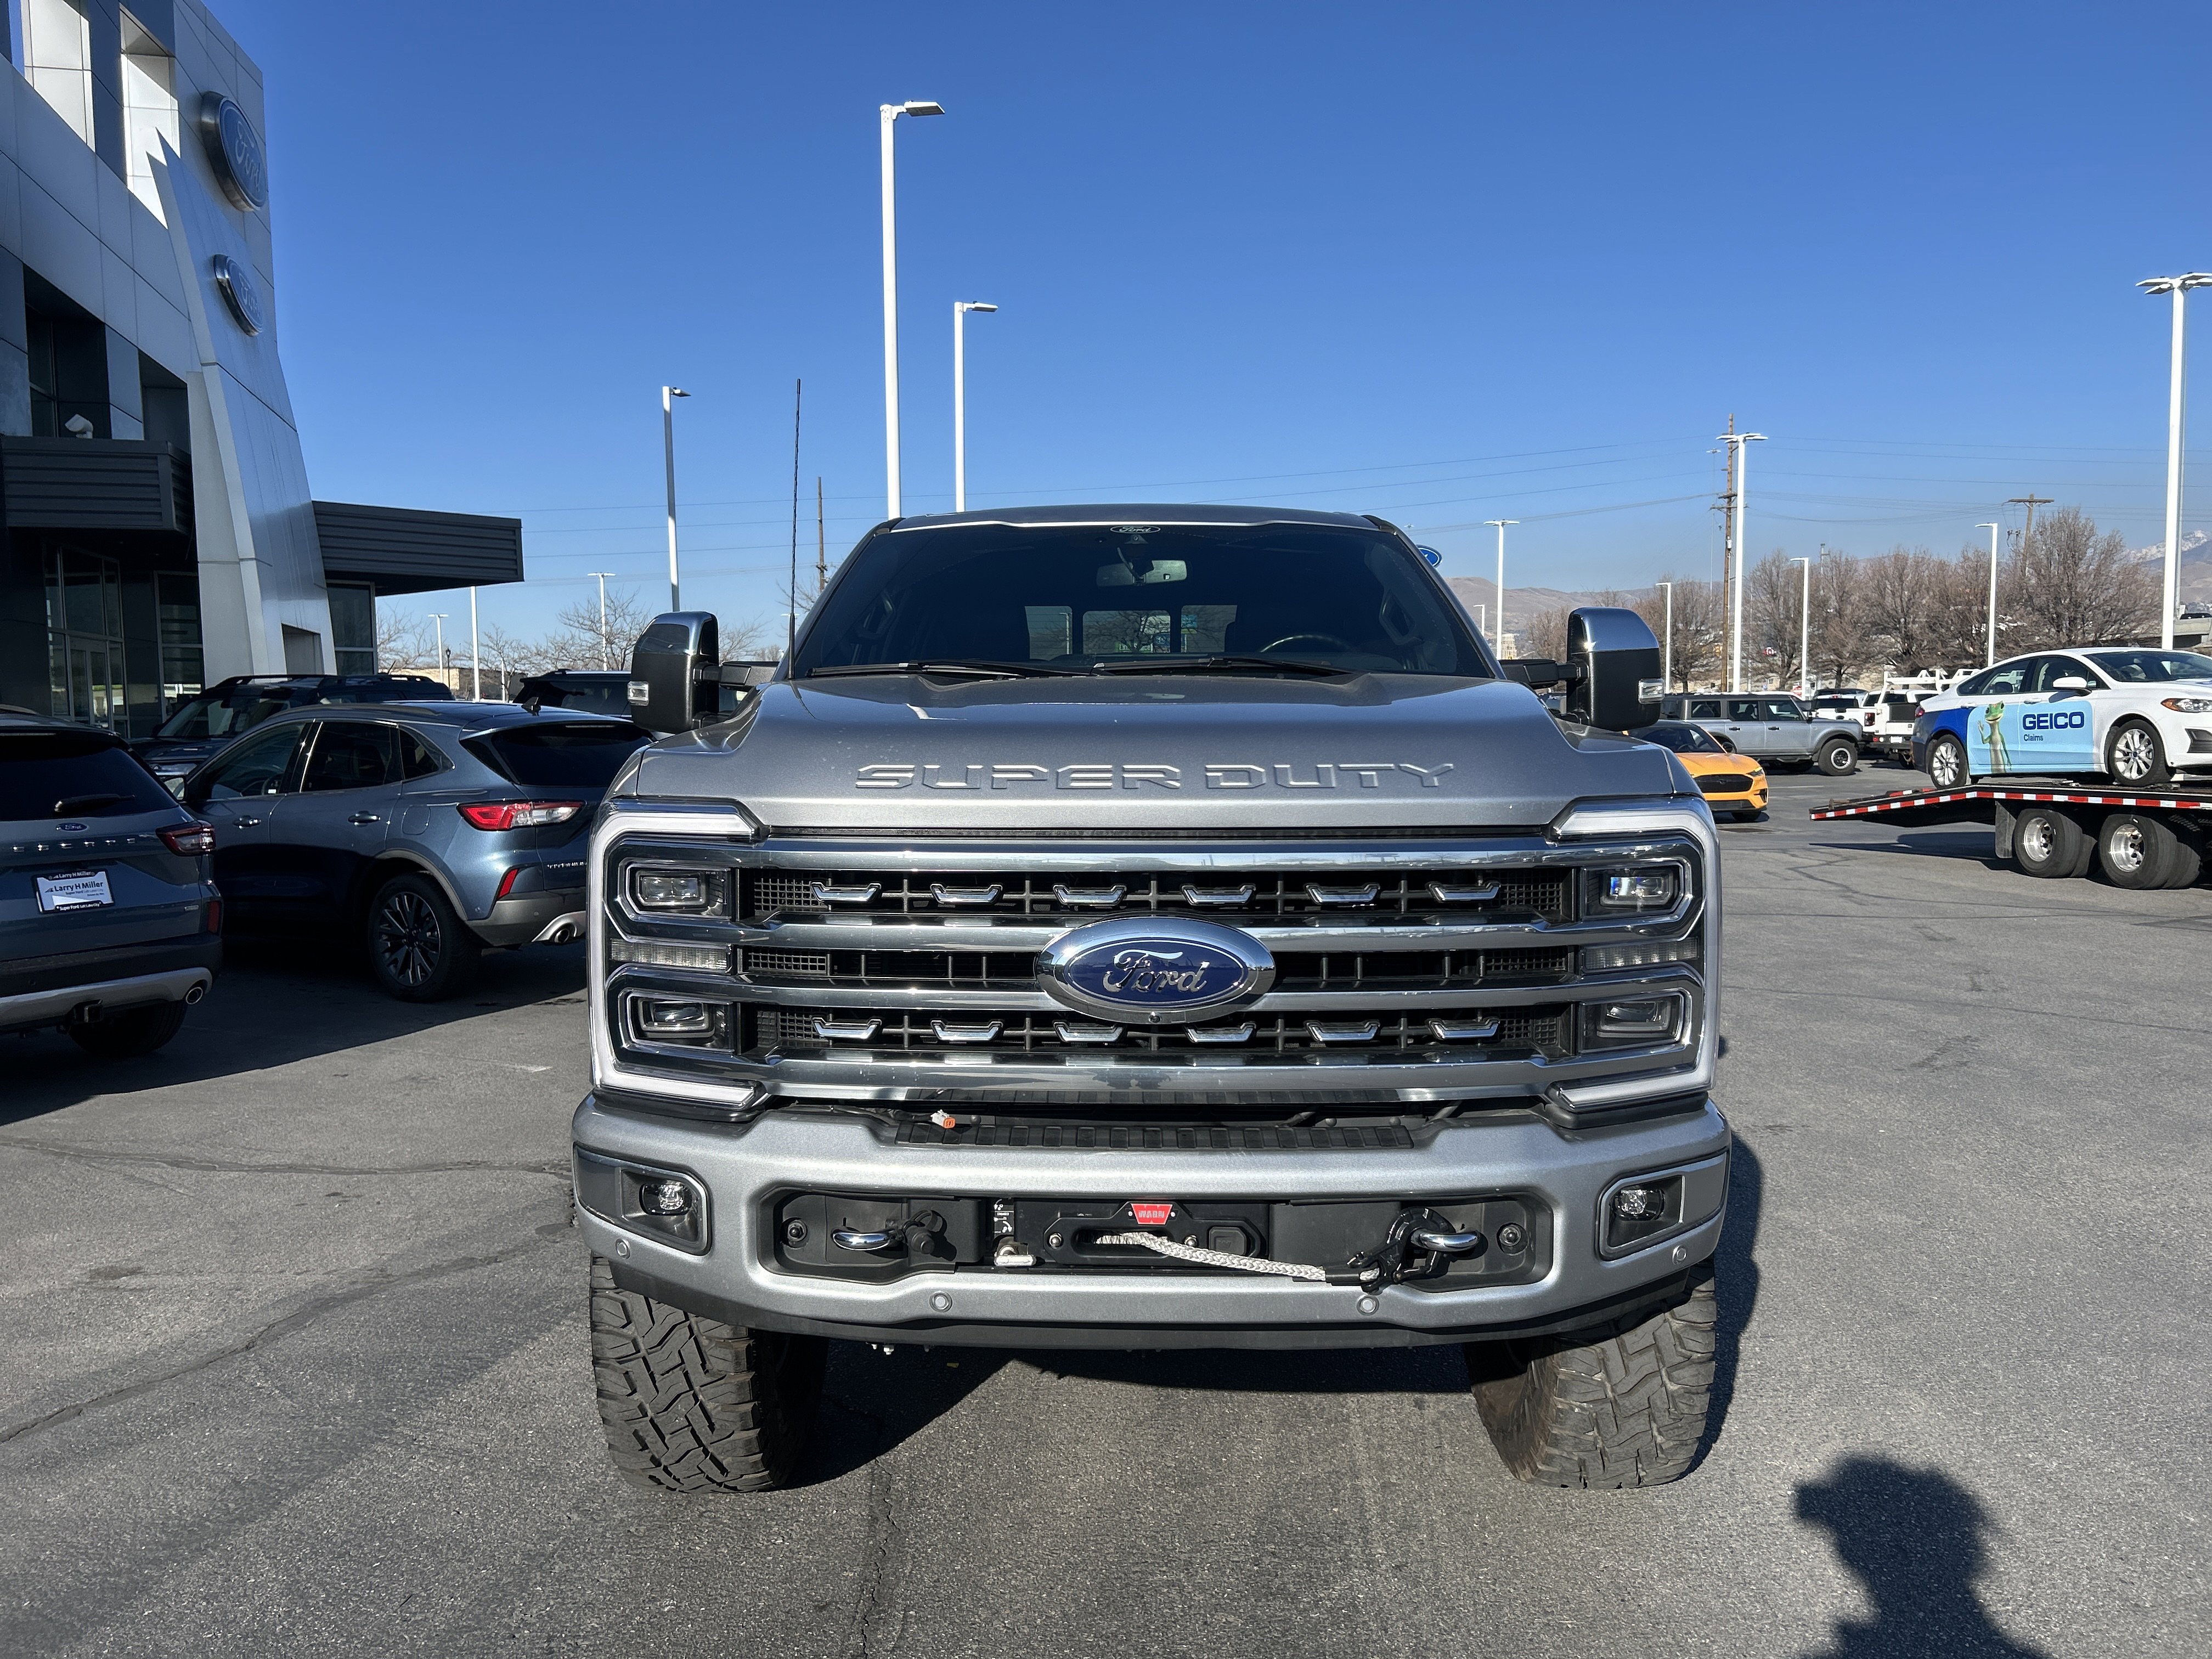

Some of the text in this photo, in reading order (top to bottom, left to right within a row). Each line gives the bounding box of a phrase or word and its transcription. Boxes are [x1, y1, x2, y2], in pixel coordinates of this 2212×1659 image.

[235, 120, 261, 193] Ford
[238, 272, 263, 321] Ford
[2022, 711, 2085, 730] GEICO
[855, 763, 1454, 789] SUPER DUTY
[1103, 950, 1210, 992] Ford
